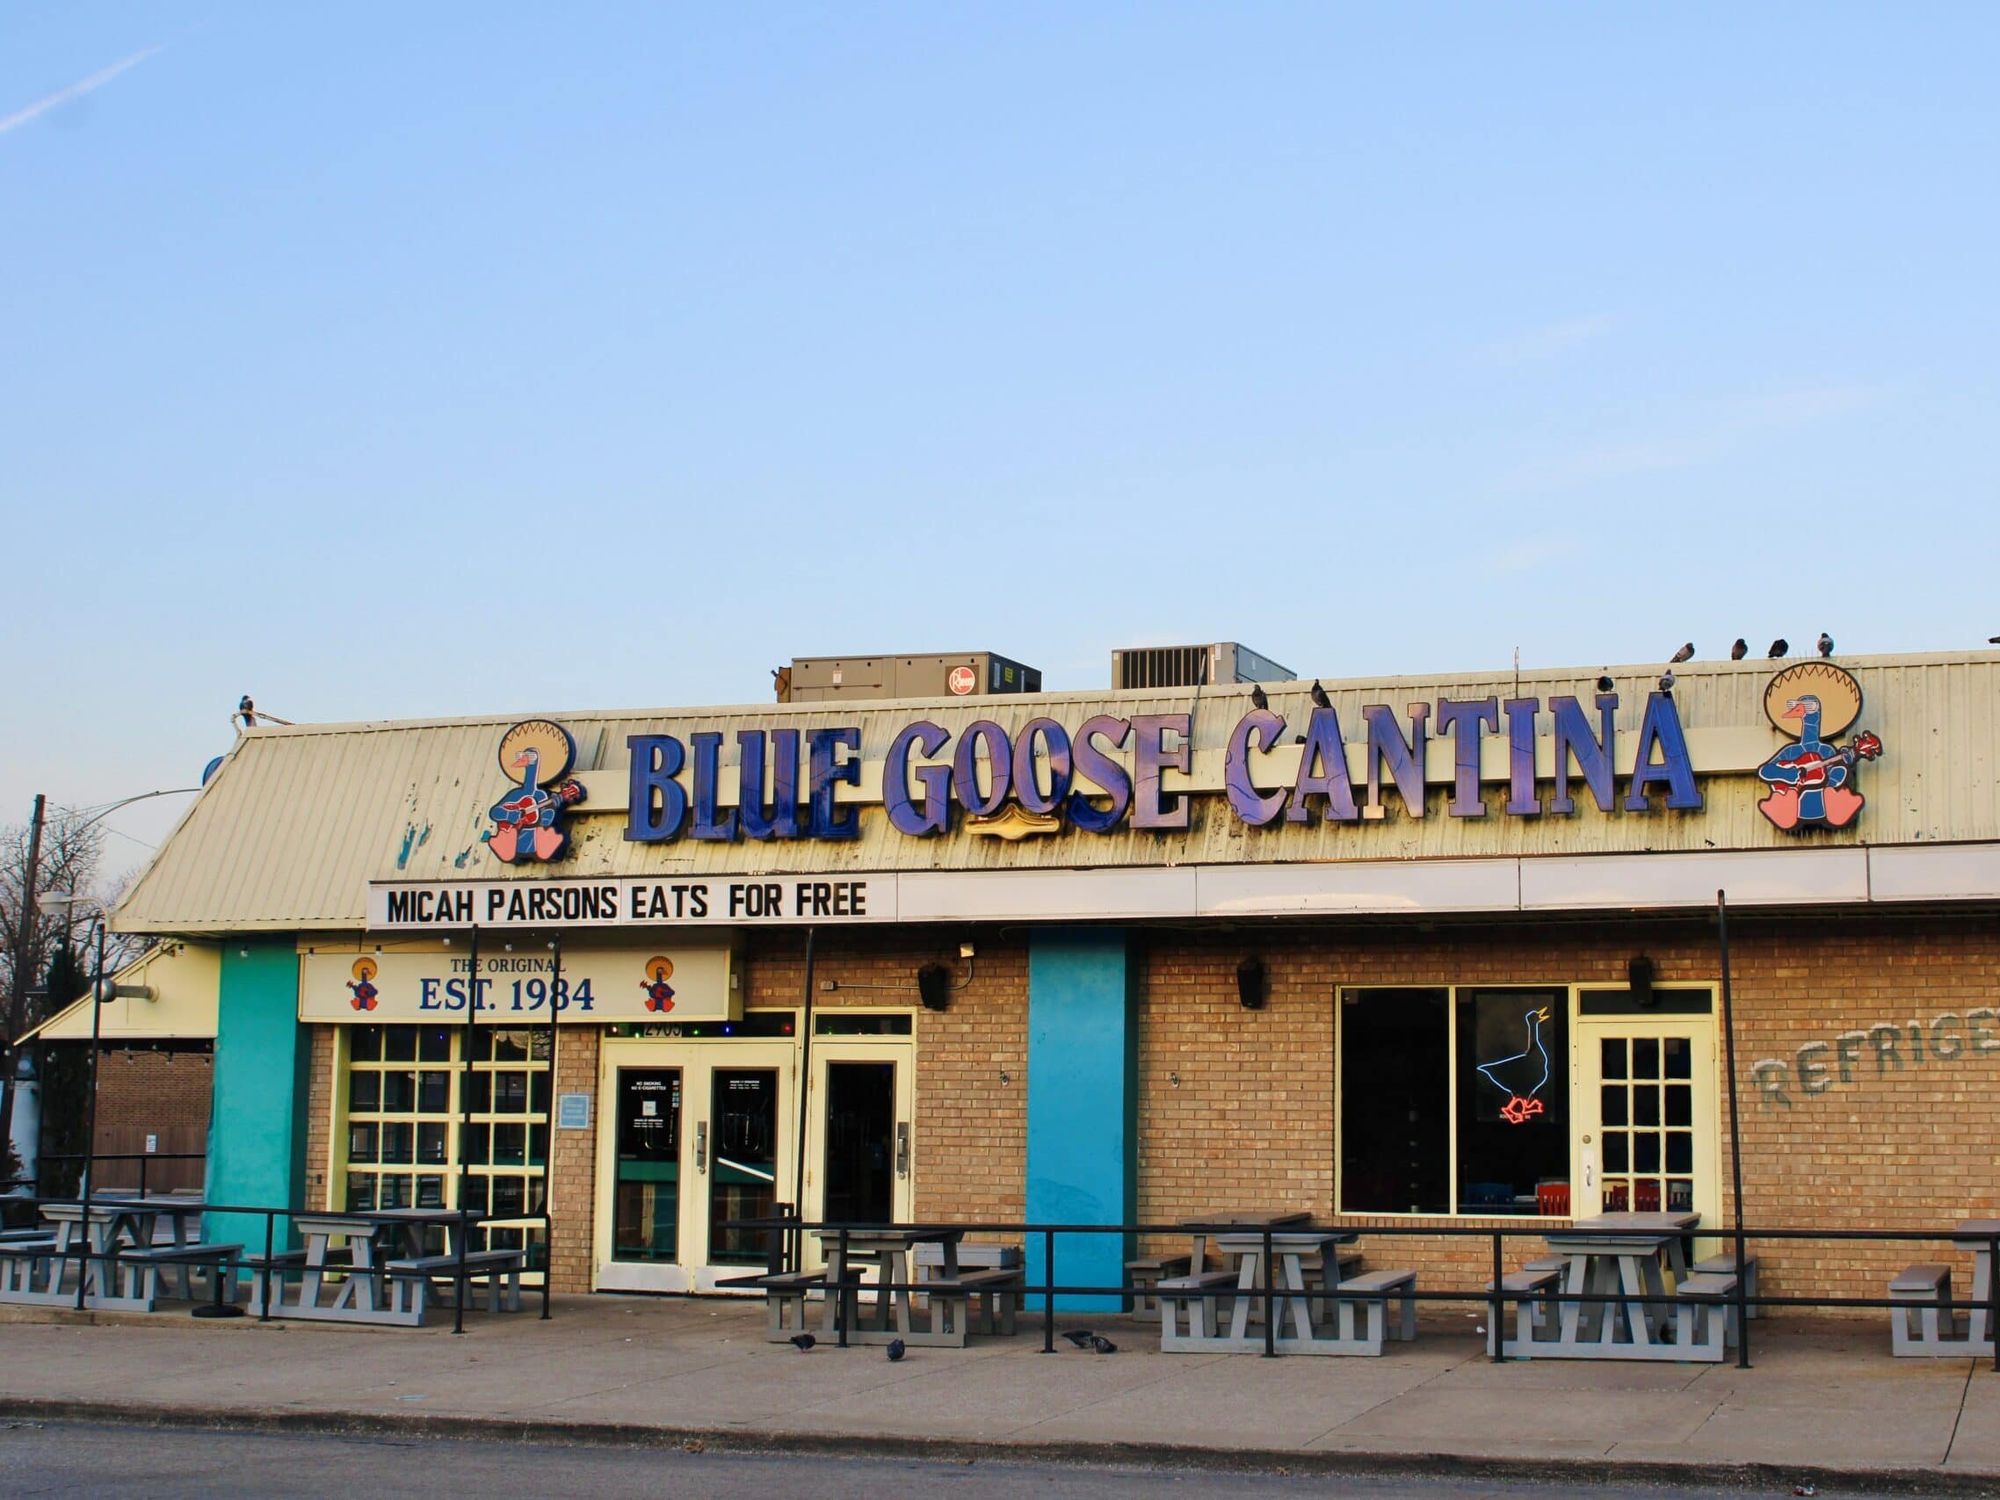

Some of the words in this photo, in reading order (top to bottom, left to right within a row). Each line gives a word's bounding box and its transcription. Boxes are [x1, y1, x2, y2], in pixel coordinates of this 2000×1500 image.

[623, 727, 861, 842] BLUE
[882, 713, 1192, 837] GOOSE
[1225, 691, 1703, 826] CANTINA
[387, 890, 474, 923] MICAH
[487, 886, 618, 921] PARSONS
[631, 884, 708, 919] EATS
[729, 883, 783, 917] FOR
[796, 882, 867, 916] FREE
[450, 958, 484, 973] THE
[487, 958, 567, 973] ORIGINAL
[419, 978, 496, 1011] EST.
[511, 978, 595, 1011] 1984
[1752, 1007, 2000, 1115] REFRIGE
